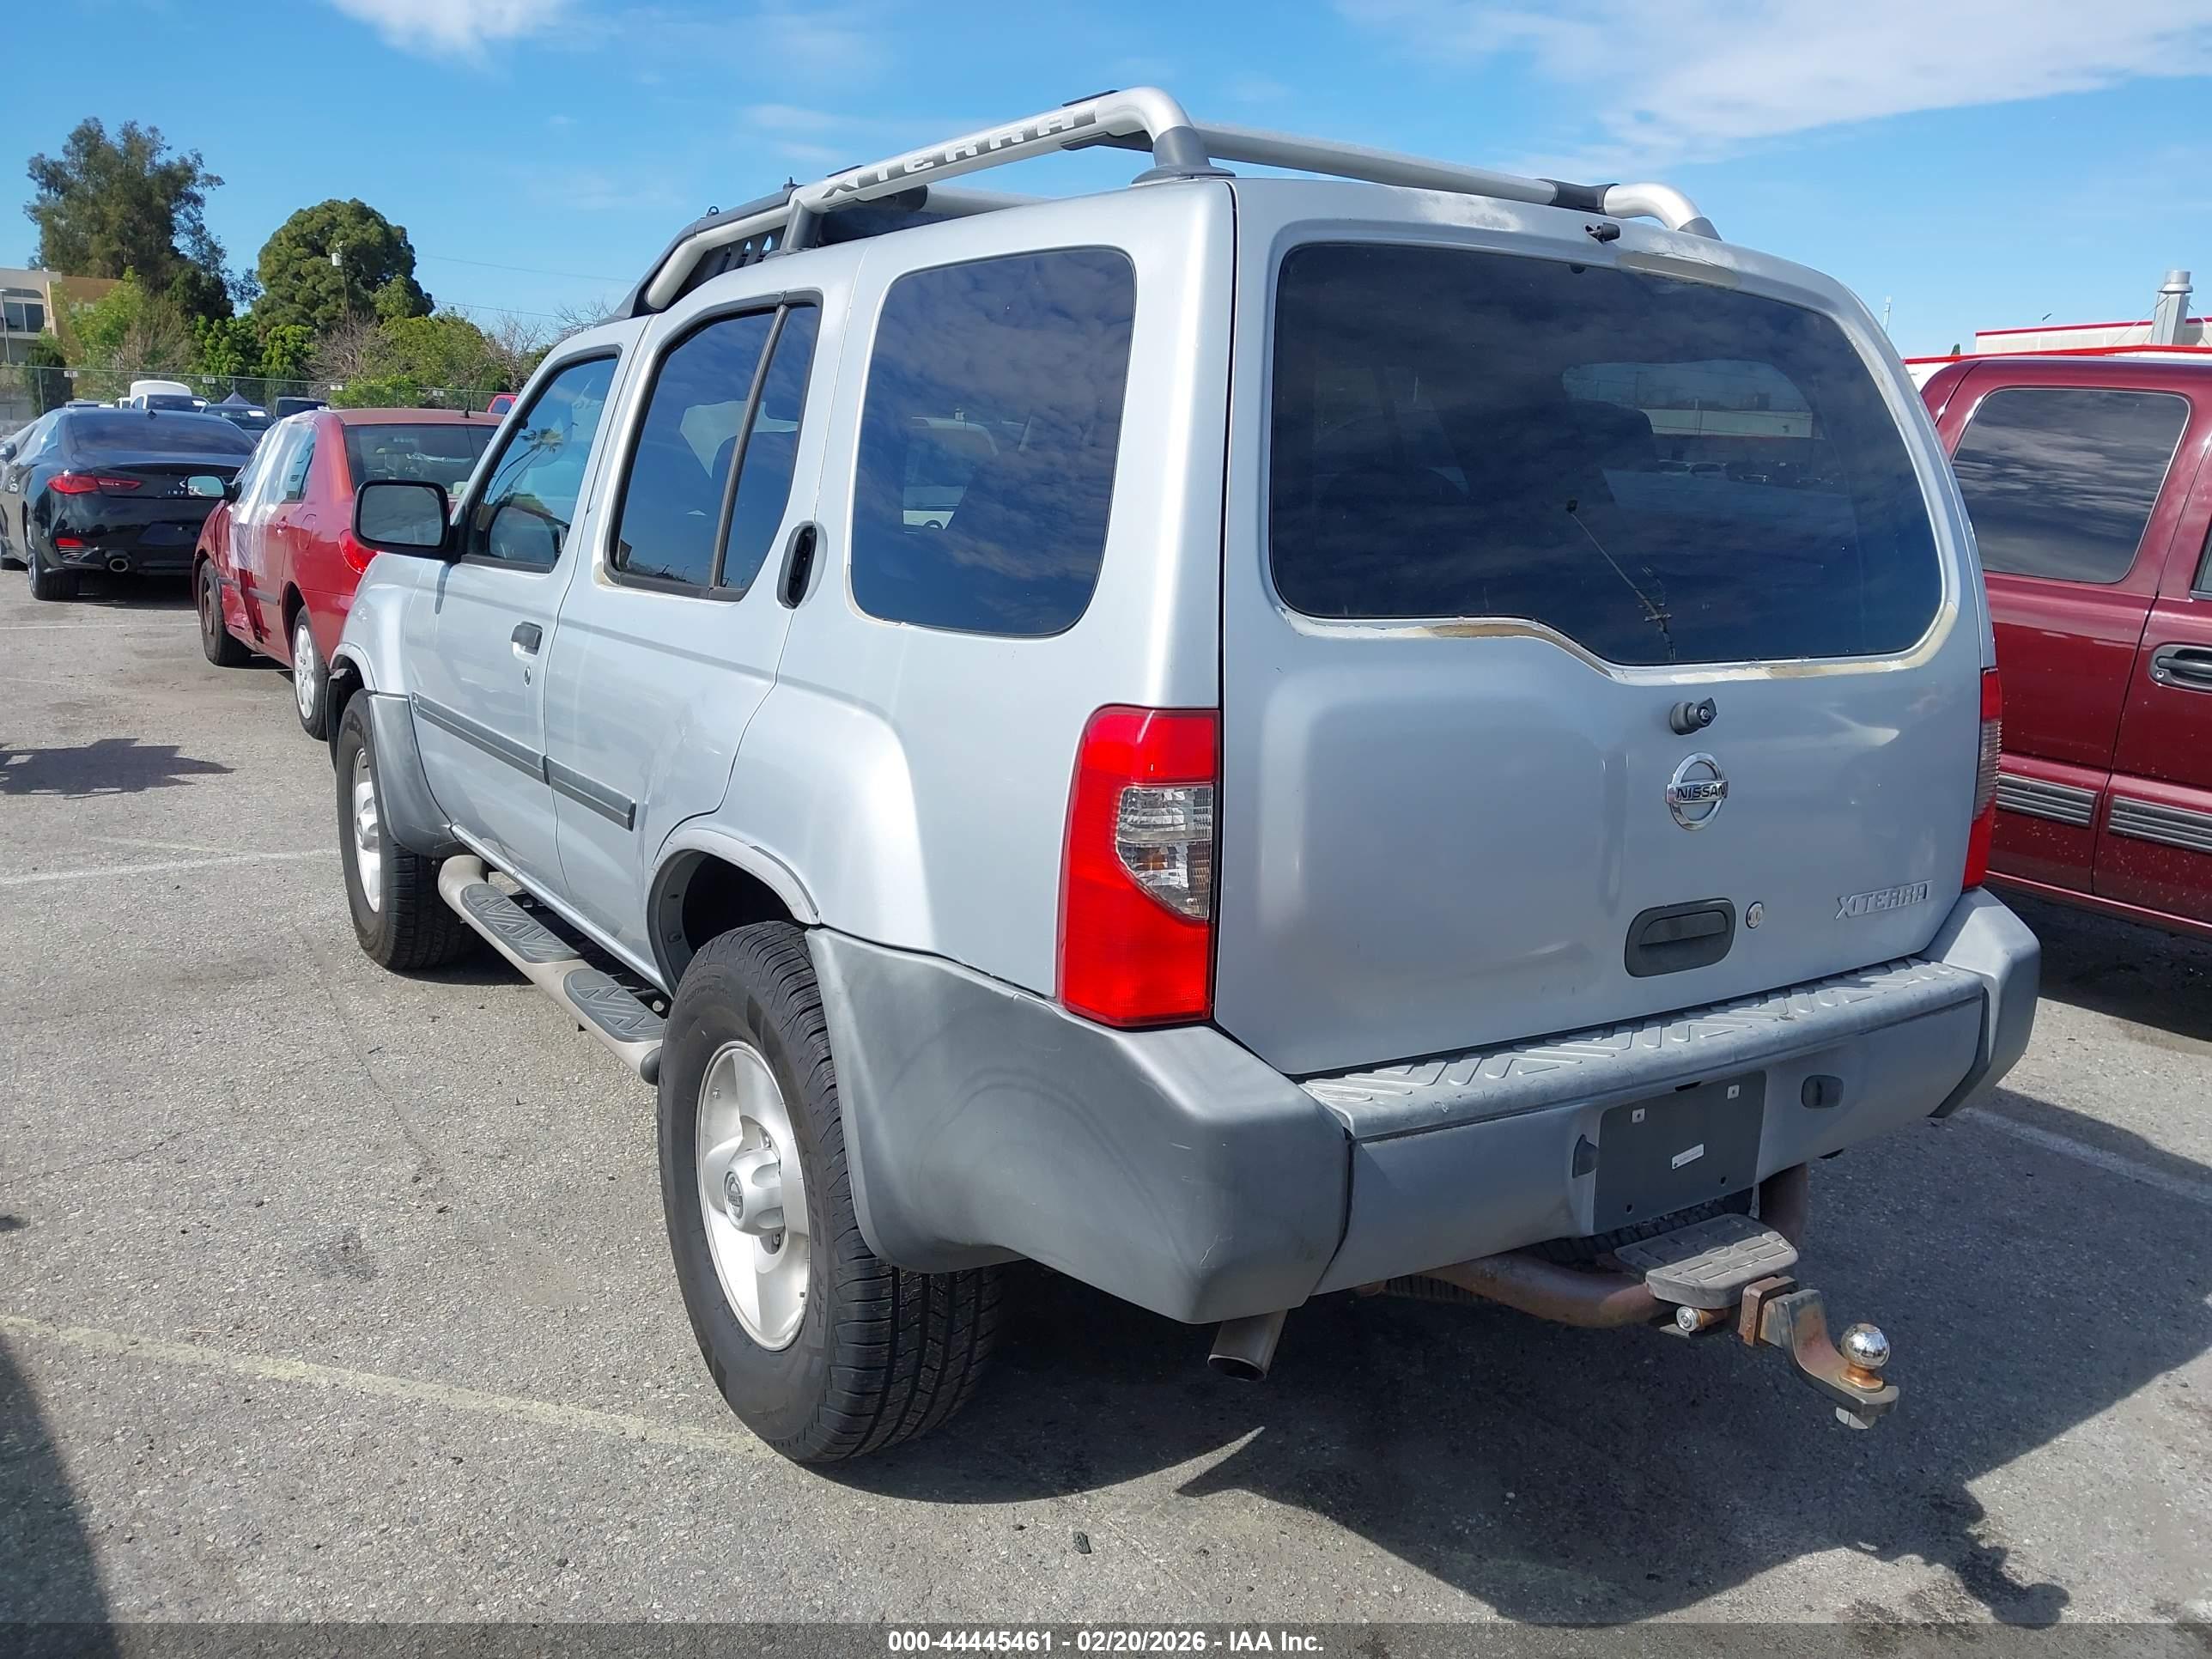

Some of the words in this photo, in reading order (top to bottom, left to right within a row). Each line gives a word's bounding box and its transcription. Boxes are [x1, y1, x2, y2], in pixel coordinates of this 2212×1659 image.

[821, 100, 1098, 199] XTERRA
[1676, 785, 1725, 799] NISSAN
[1834, 879, 1932, 920] XTERRA
